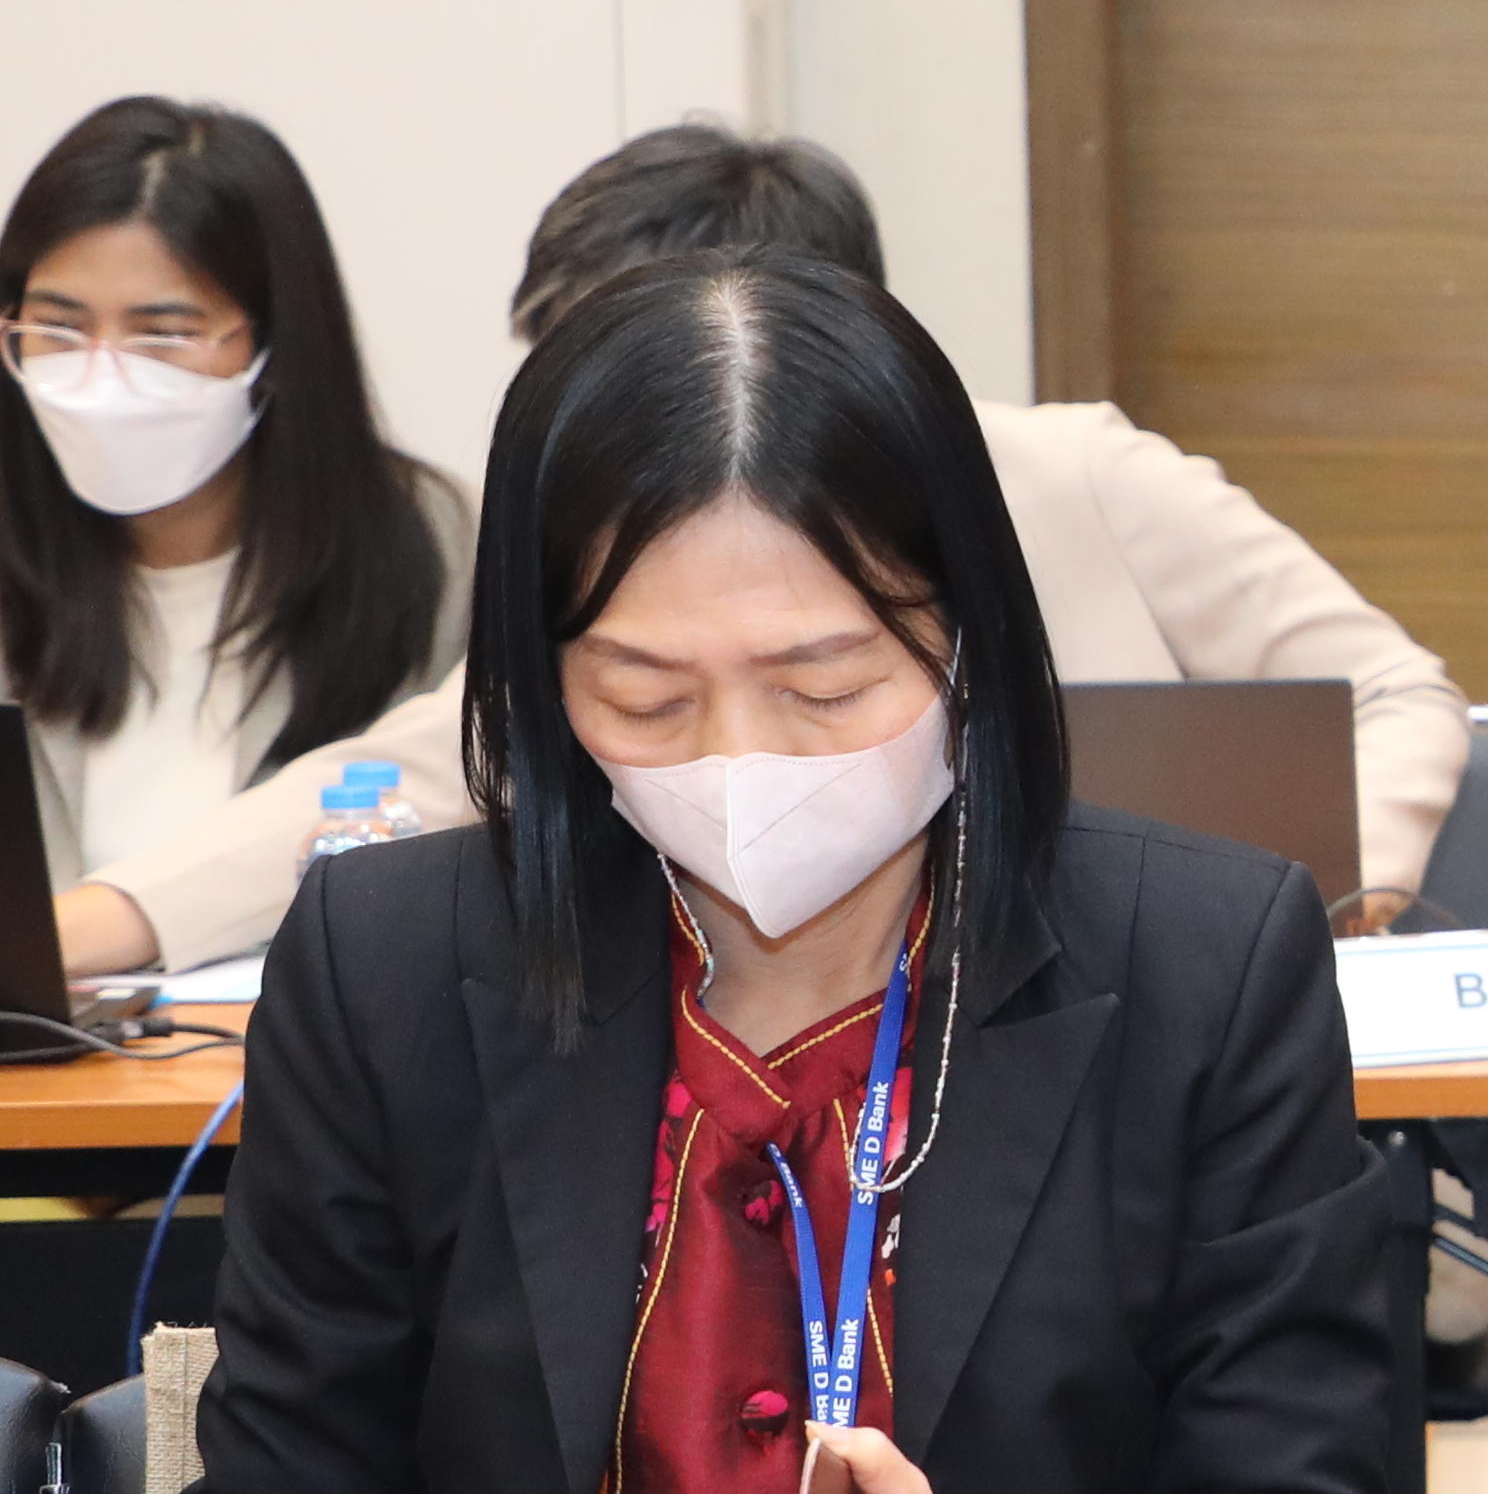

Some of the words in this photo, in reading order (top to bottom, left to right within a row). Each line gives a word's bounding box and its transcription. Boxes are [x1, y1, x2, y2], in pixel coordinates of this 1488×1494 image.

[867, 1081, 889, 1132] Bank
[864, 1136, 881, 1154] D
[857, 1158, 879, 1205] SME
[809, 1320, 828, 1367] SME
[837, 1318, 859, 1370] Bank
[814, 1372, 829, 1389] D
[835, 1374, 853, 1392] D
[816, 1394, 829, 1422] Ba
[832, 1397, 851, 1428] ME
